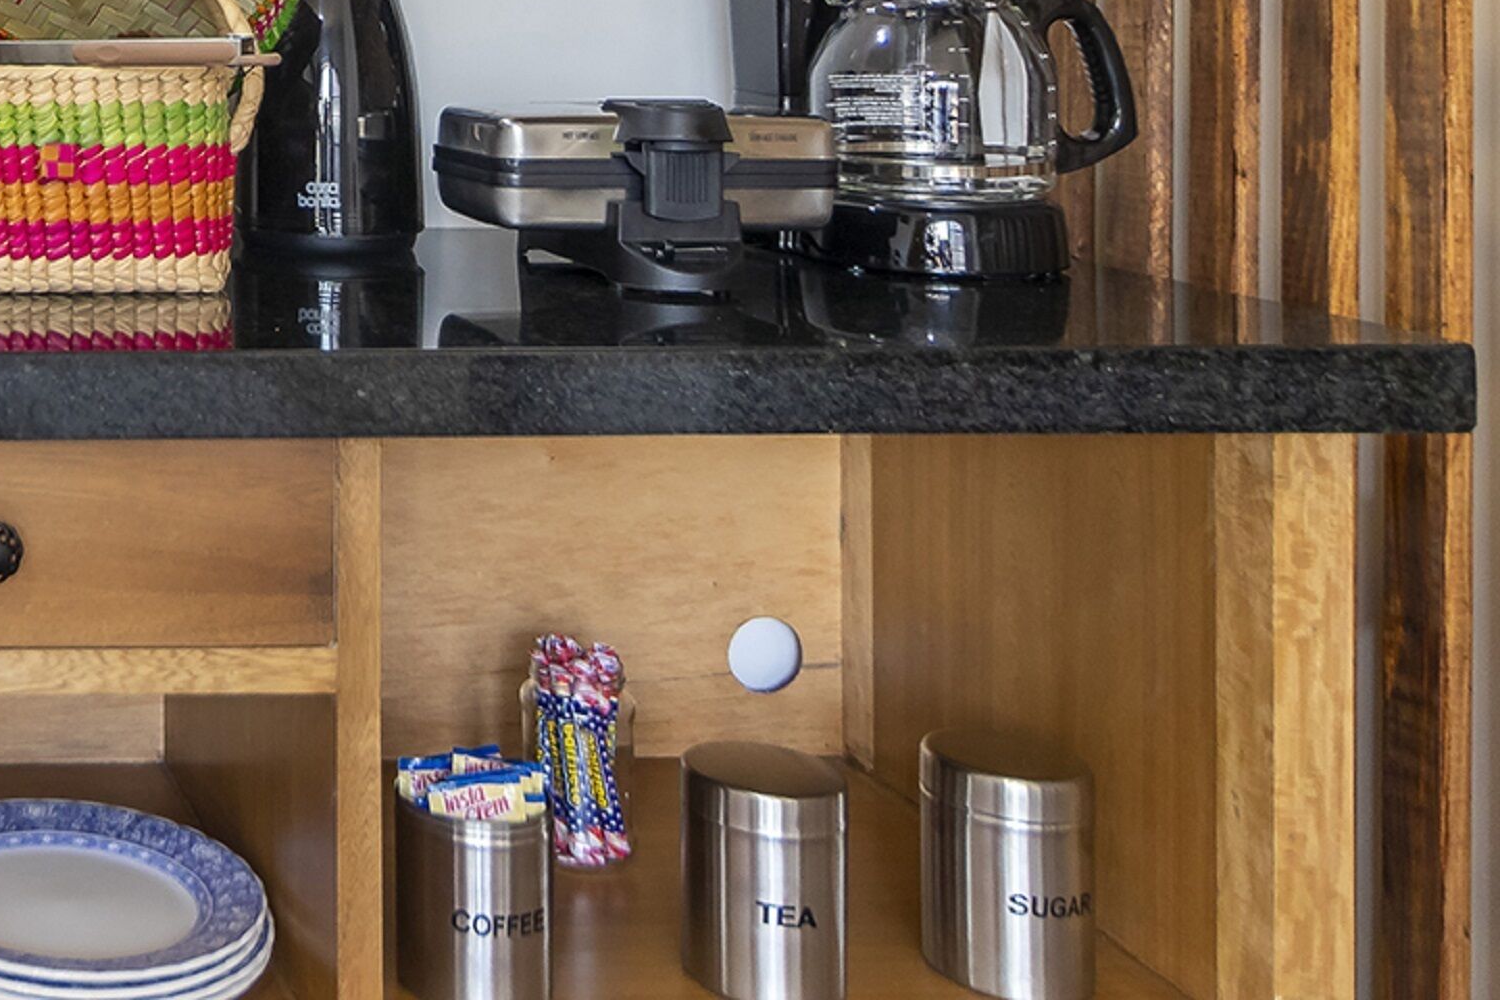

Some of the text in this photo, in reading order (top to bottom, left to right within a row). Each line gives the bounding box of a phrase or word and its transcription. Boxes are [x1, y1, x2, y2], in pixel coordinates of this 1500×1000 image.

[442, 785, 486, 814] insta
[755, 900, 817, 928] TEA
[1007, 893, 1093, 919] SUGAR
[451, 907, 545, 938] COFFEE
